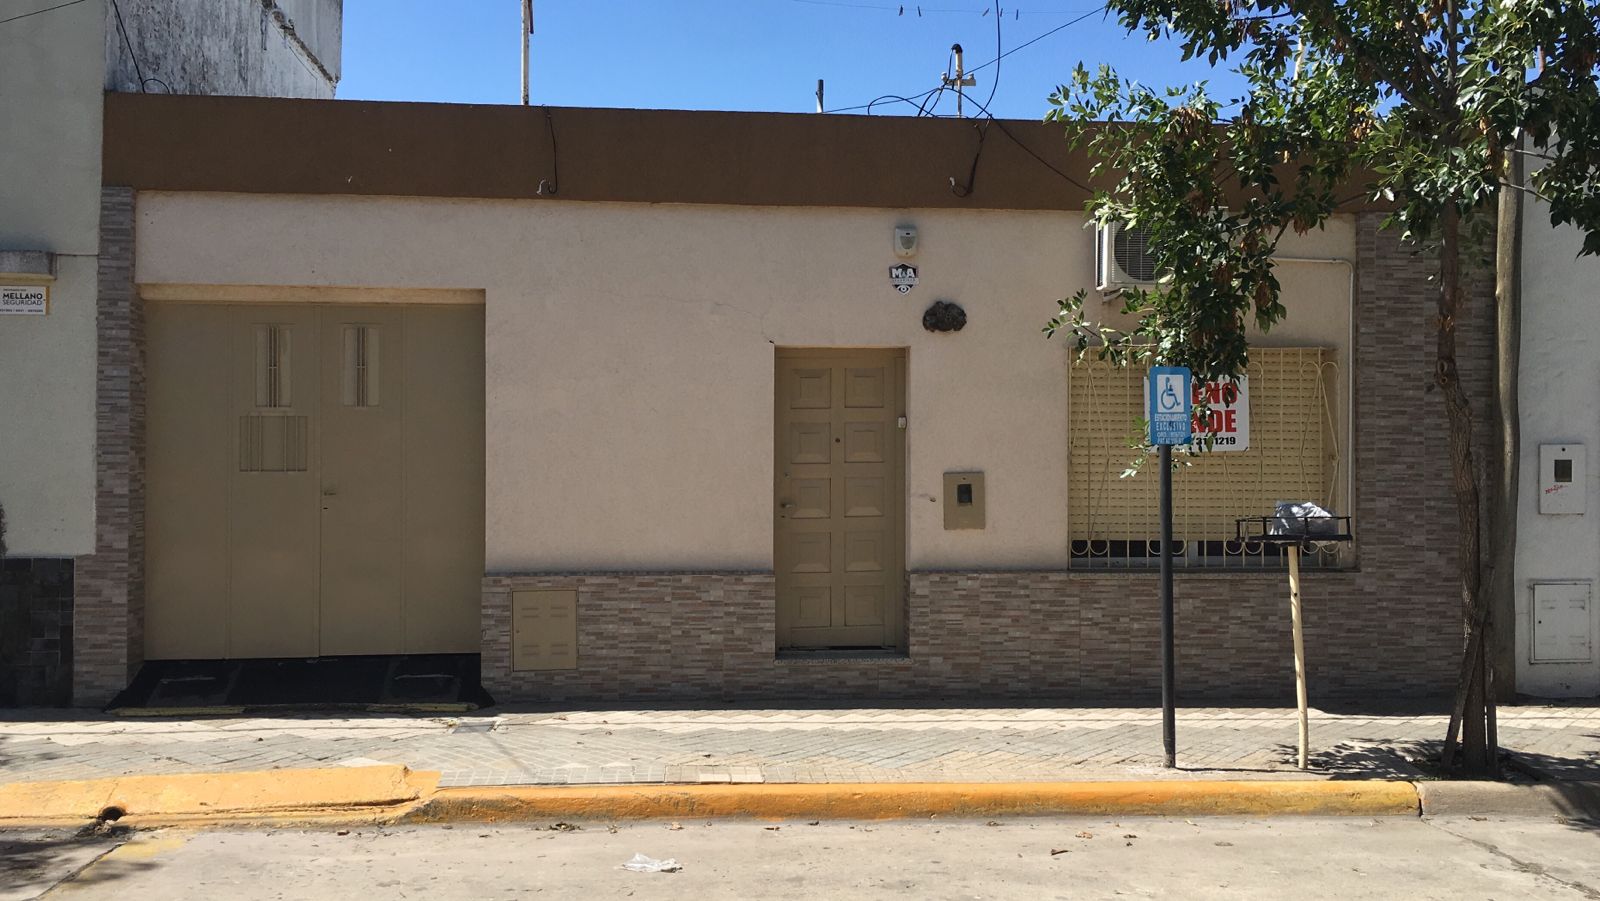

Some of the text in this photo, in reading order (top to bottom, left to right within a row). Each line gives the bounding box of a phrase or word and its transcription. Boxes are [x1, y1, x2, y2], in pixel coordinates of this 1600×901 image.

[1191, 382, 1237, 404] ENO
[1191, 409, 1237, 433] NDE
[1196, 437, 1236, 445] 311219
